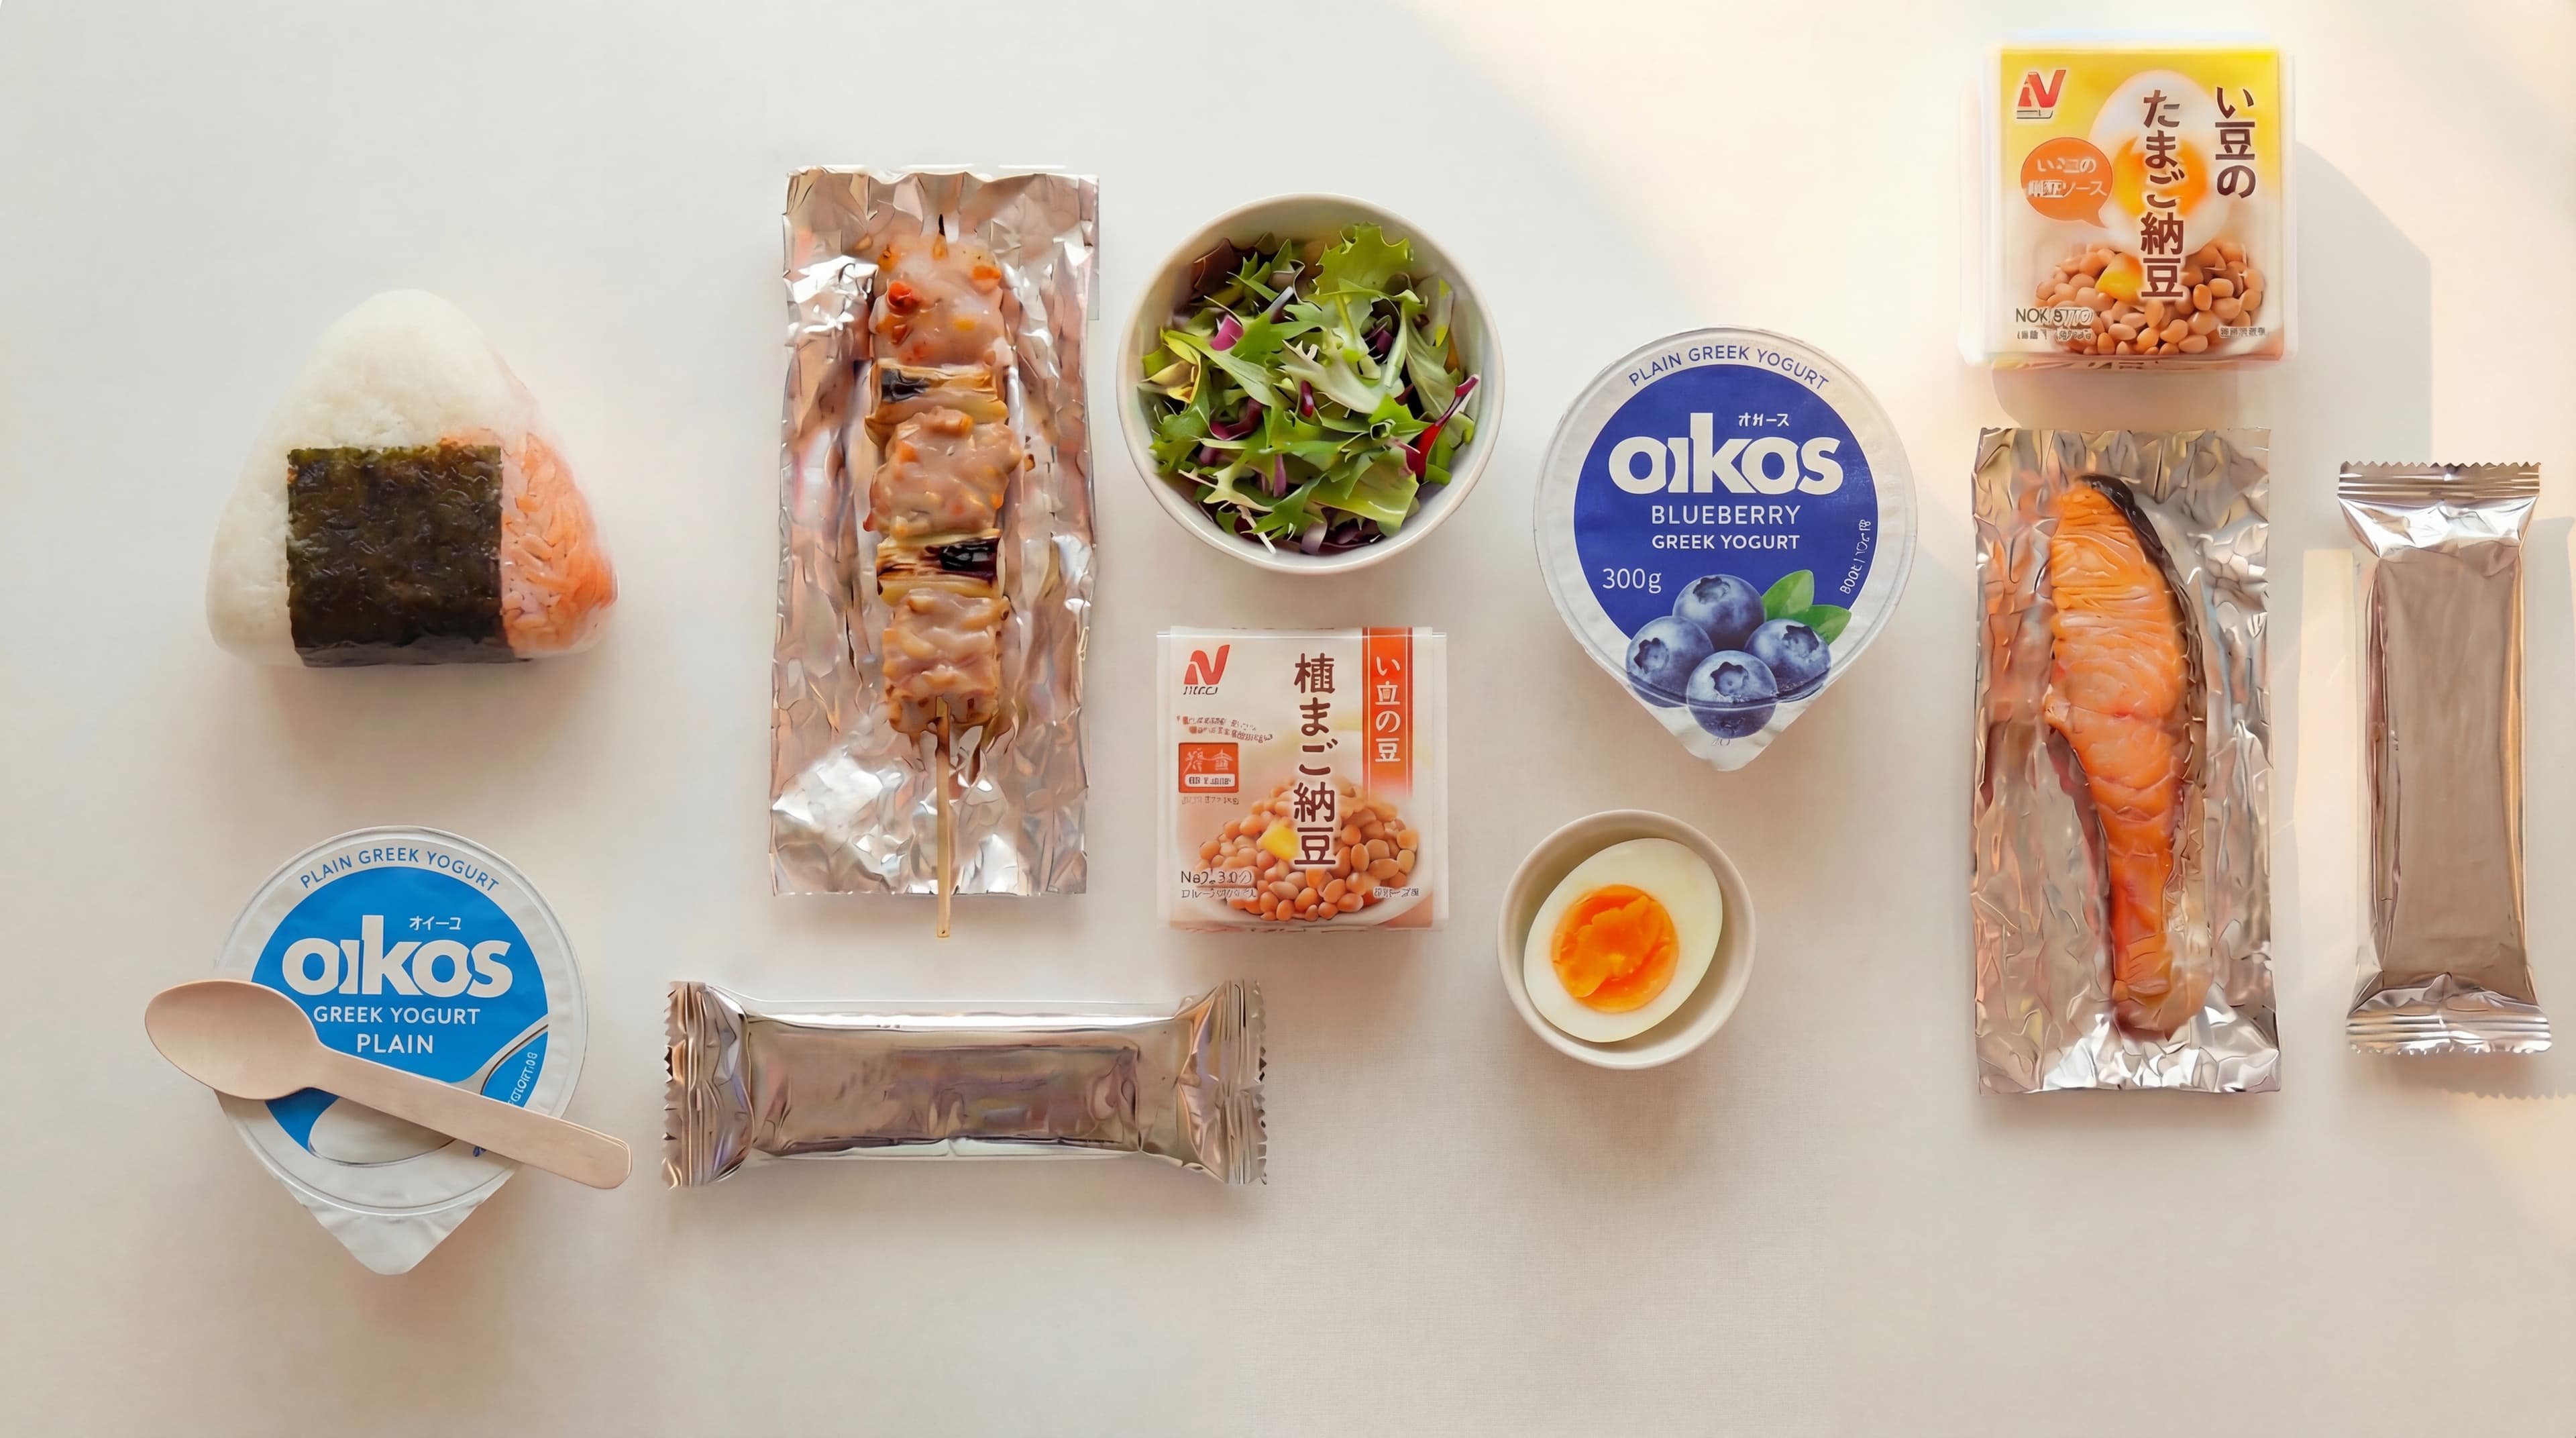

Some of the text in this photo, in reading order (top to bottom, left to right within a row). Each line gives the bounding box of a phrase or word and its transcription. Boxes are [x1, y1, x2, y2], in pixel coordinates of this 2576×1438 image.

[2214, 87, 2257, 199] い豆の
[2140, 89, 2184, 298] たまご納豆
[1629, 346, 1829, 391] PLAIN GREEK YOGURT
[1609, 412, 1843, 495] oikos
[1652, 505, 1801, 525] BLUEBERRY
[1652, 535, 1801, 550] GREEK YOGURT
[1602, 568, 1662, 594] 300g
[299, 848, 500, 892] PLAIN GREEK YOGURT
[282, 915, 513, 998] oikos
[313, 1006, 481, 1025] GREEK YOGURT
[357, 1034, 433, 1054] PLAIN
